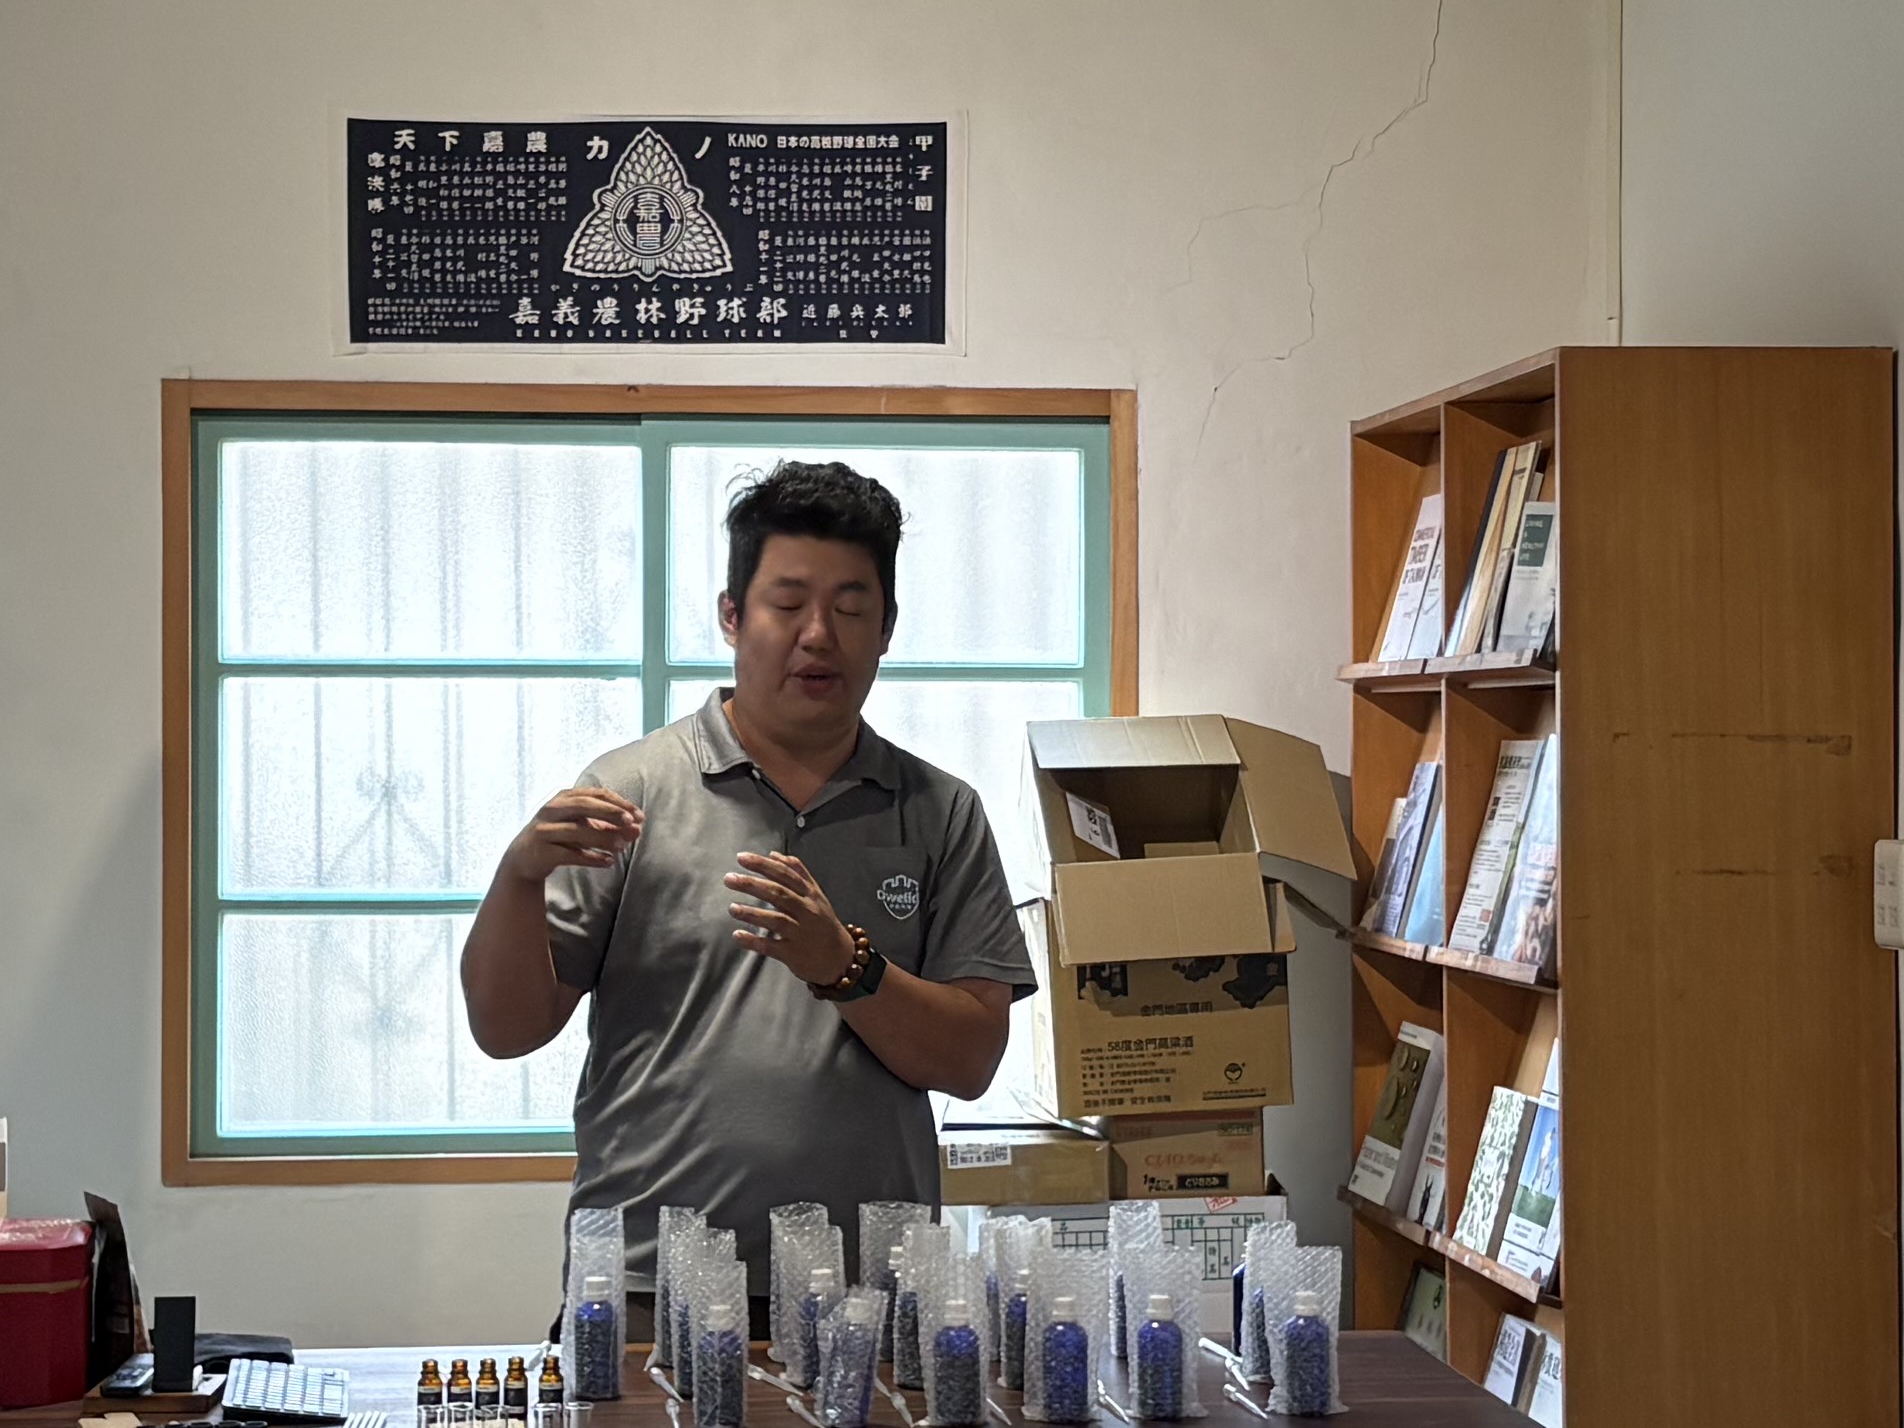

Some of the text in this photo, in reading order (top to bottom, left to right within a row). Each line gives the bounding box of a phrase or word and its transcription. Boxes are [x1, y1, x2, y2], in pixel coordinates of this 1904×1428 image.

[728, 133, 768, 148] KANO
[508, 296, 789, 325] 嘉義農林野球部
